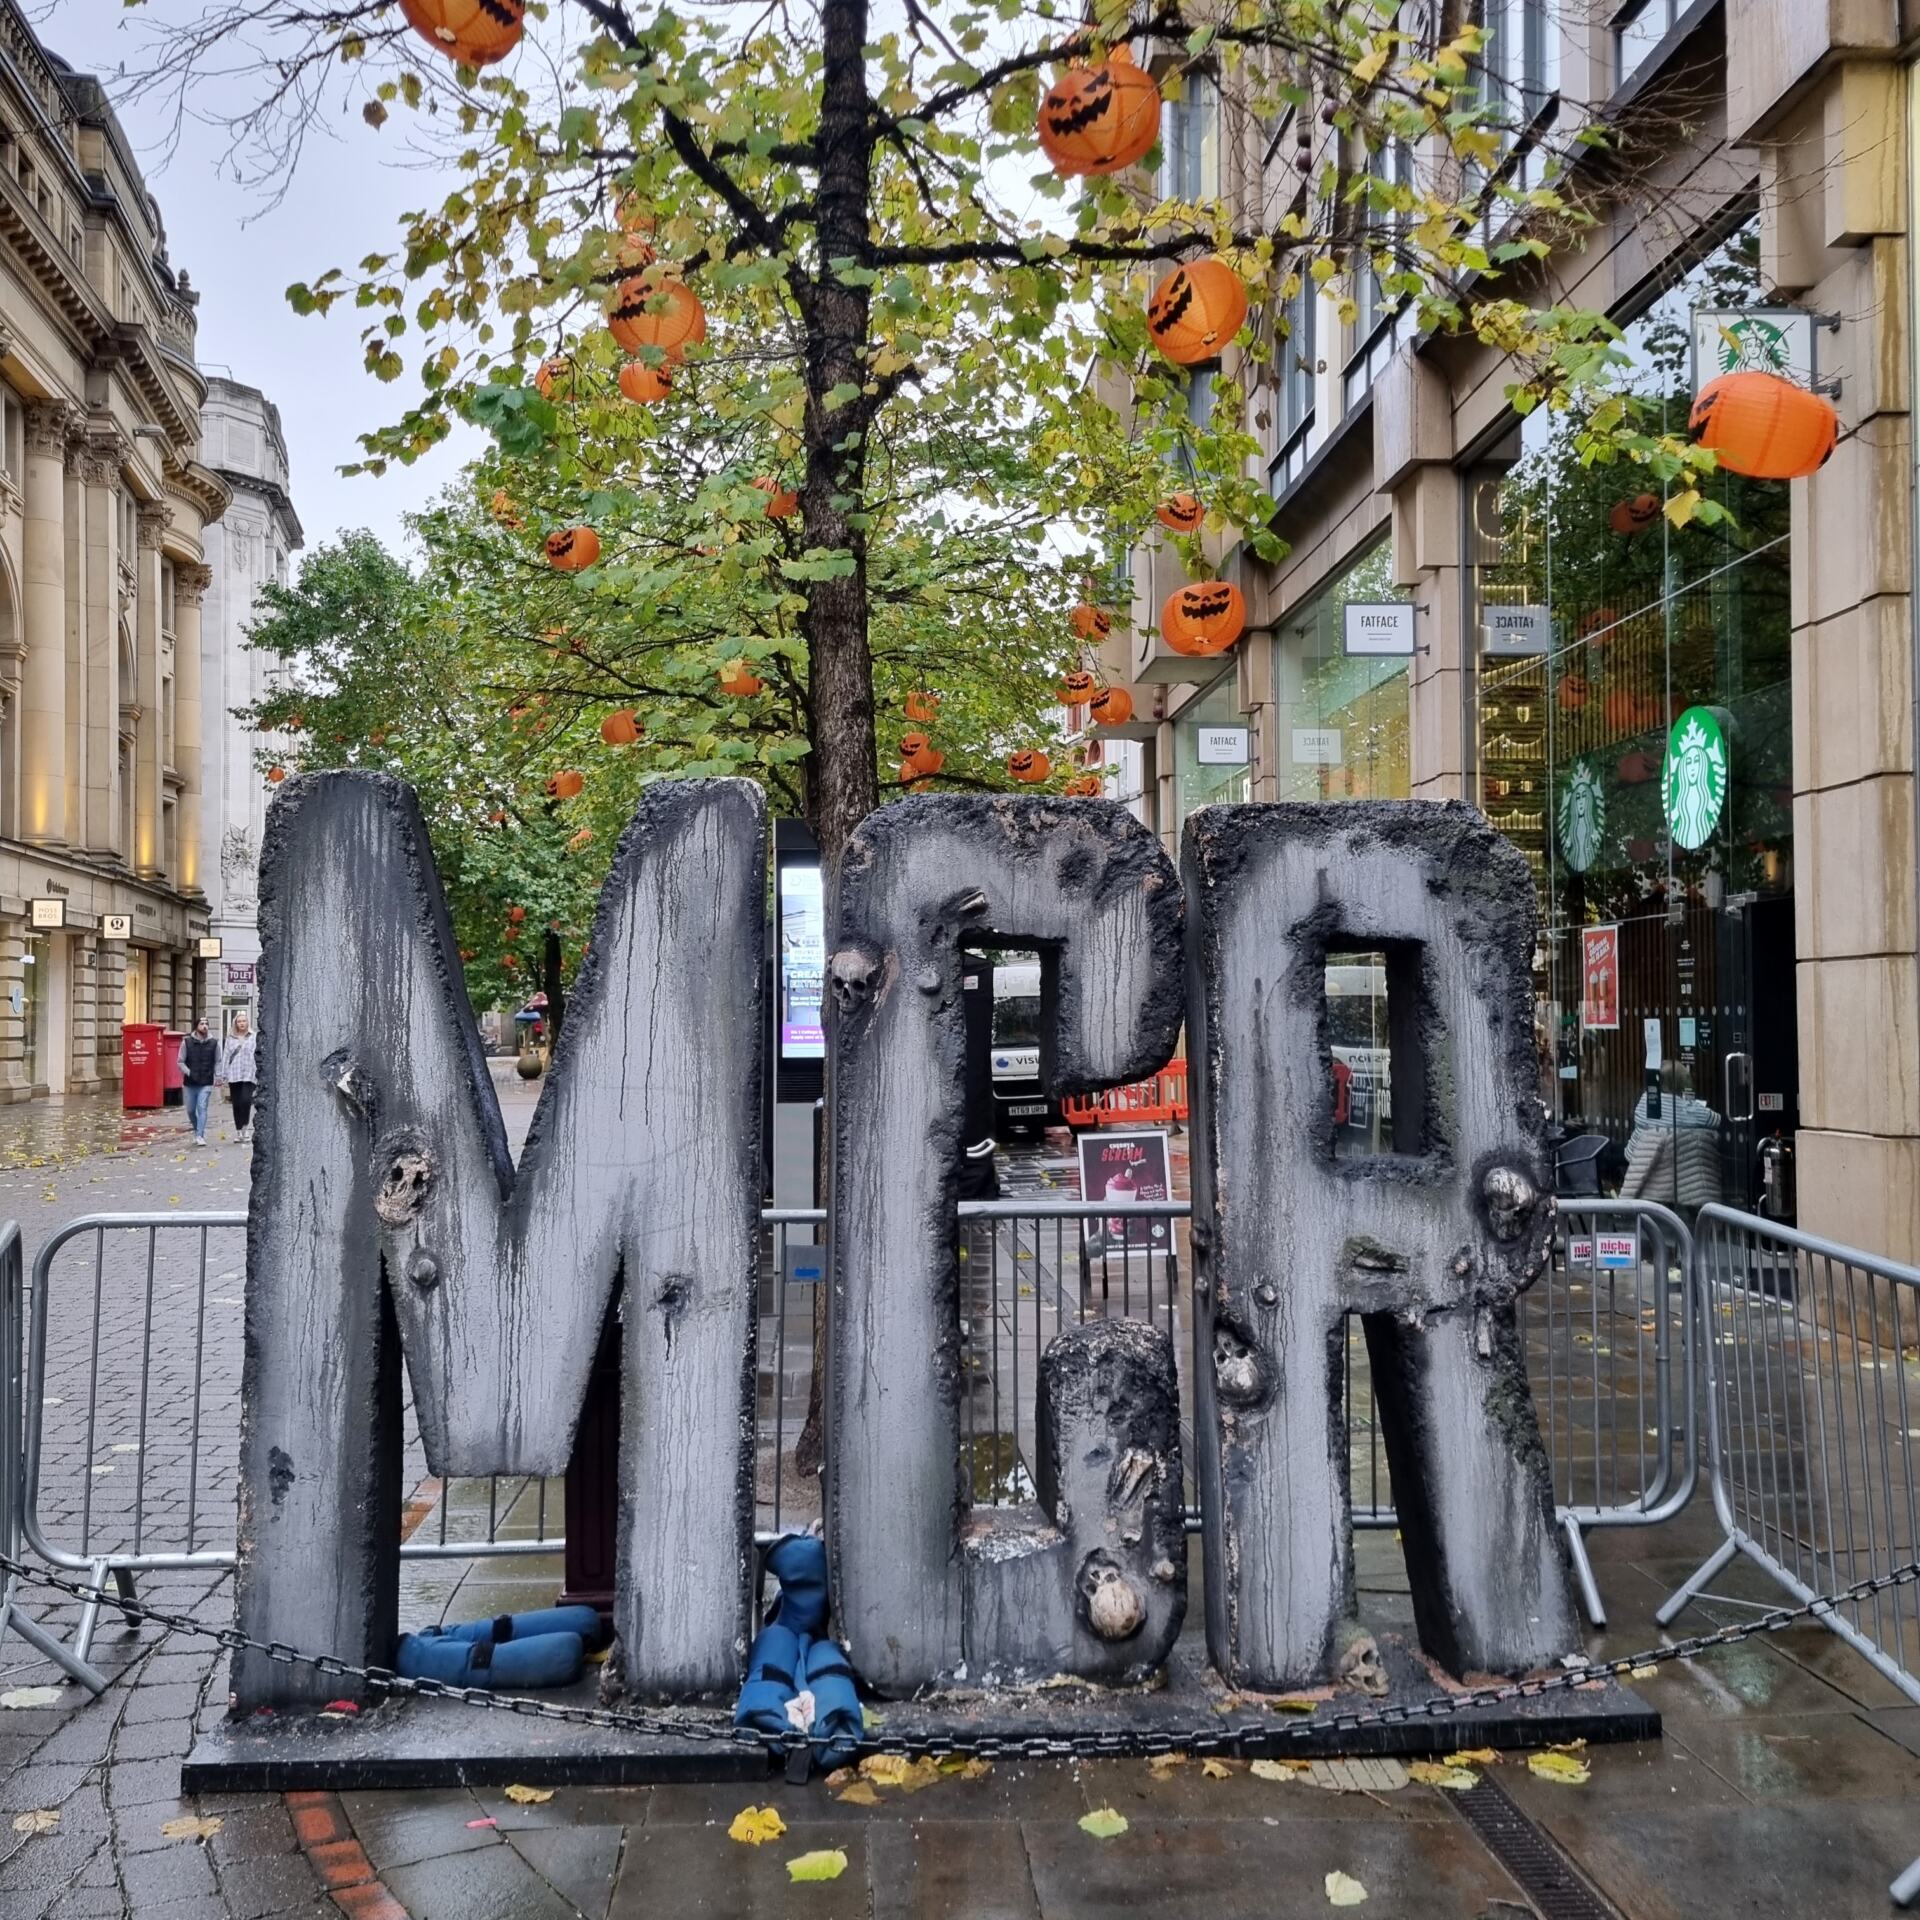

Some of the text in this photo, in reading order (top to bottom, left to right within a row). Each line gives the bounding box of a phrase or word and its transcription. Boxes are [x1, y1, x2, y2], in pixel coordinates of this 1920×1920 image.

[1360, 615, 1399, 628] FATFACE
[1210, 736, 1237, 746] FATFACE
[229, 971, 252, 980] TO LET
[1015, 1055, 1040, 1065] visi
[1102, 1147, 1144, 1161] SCREAM
[1574, 1243, 1592, 1254] nic
[1600, 1240, 1631, 1251] niche
